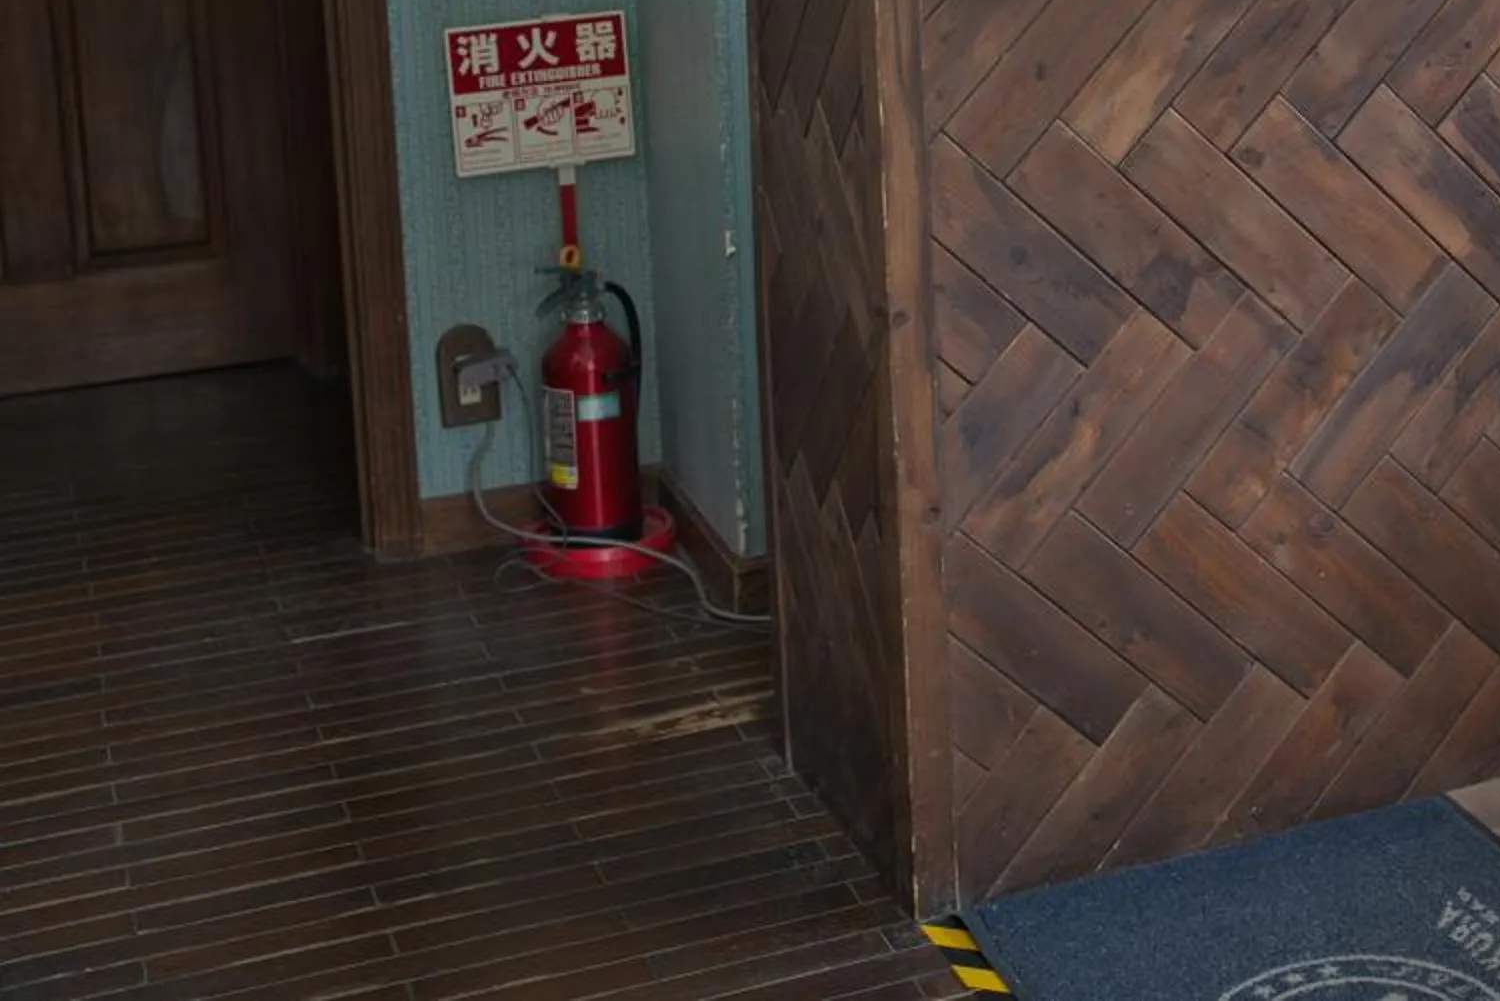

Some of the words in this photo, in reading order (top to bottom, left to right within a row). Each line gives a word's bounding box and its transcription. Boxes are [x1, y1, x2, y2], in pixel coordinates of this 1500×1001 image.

[457, 21, 616, 76] 消火器
[478, 74, 507, 90] FIRE
[510, 62, 602, 87] EXTINGUISHER
